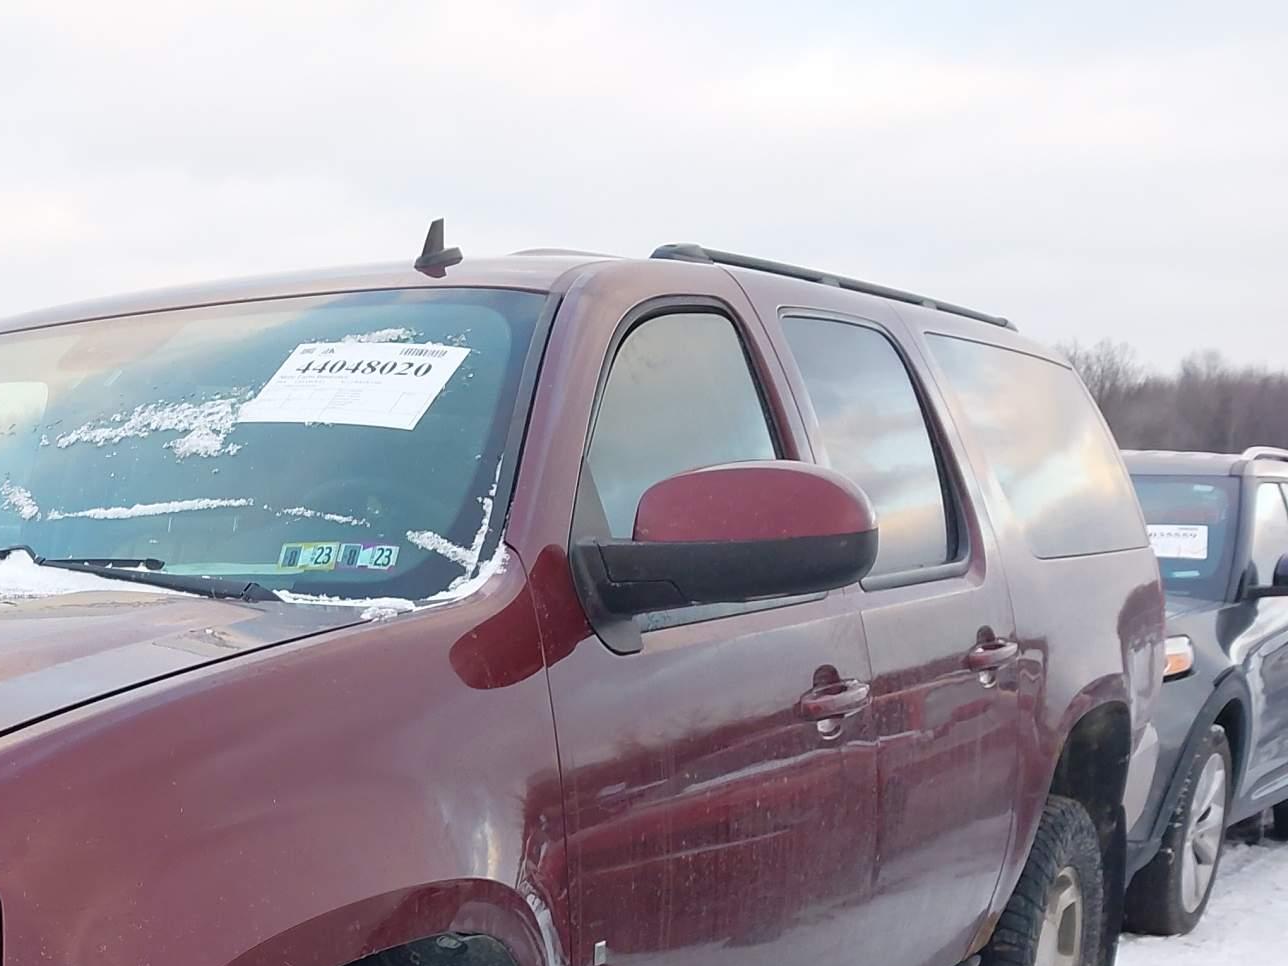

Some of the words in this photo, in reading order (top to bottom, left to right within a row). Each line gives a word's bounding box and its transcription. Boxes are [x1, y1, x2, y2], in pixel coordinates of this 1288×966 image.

[295, 358, 434, 378] 44048020
[314, 546, 333, 566] 23
[374, 547, 393, 567] 23
